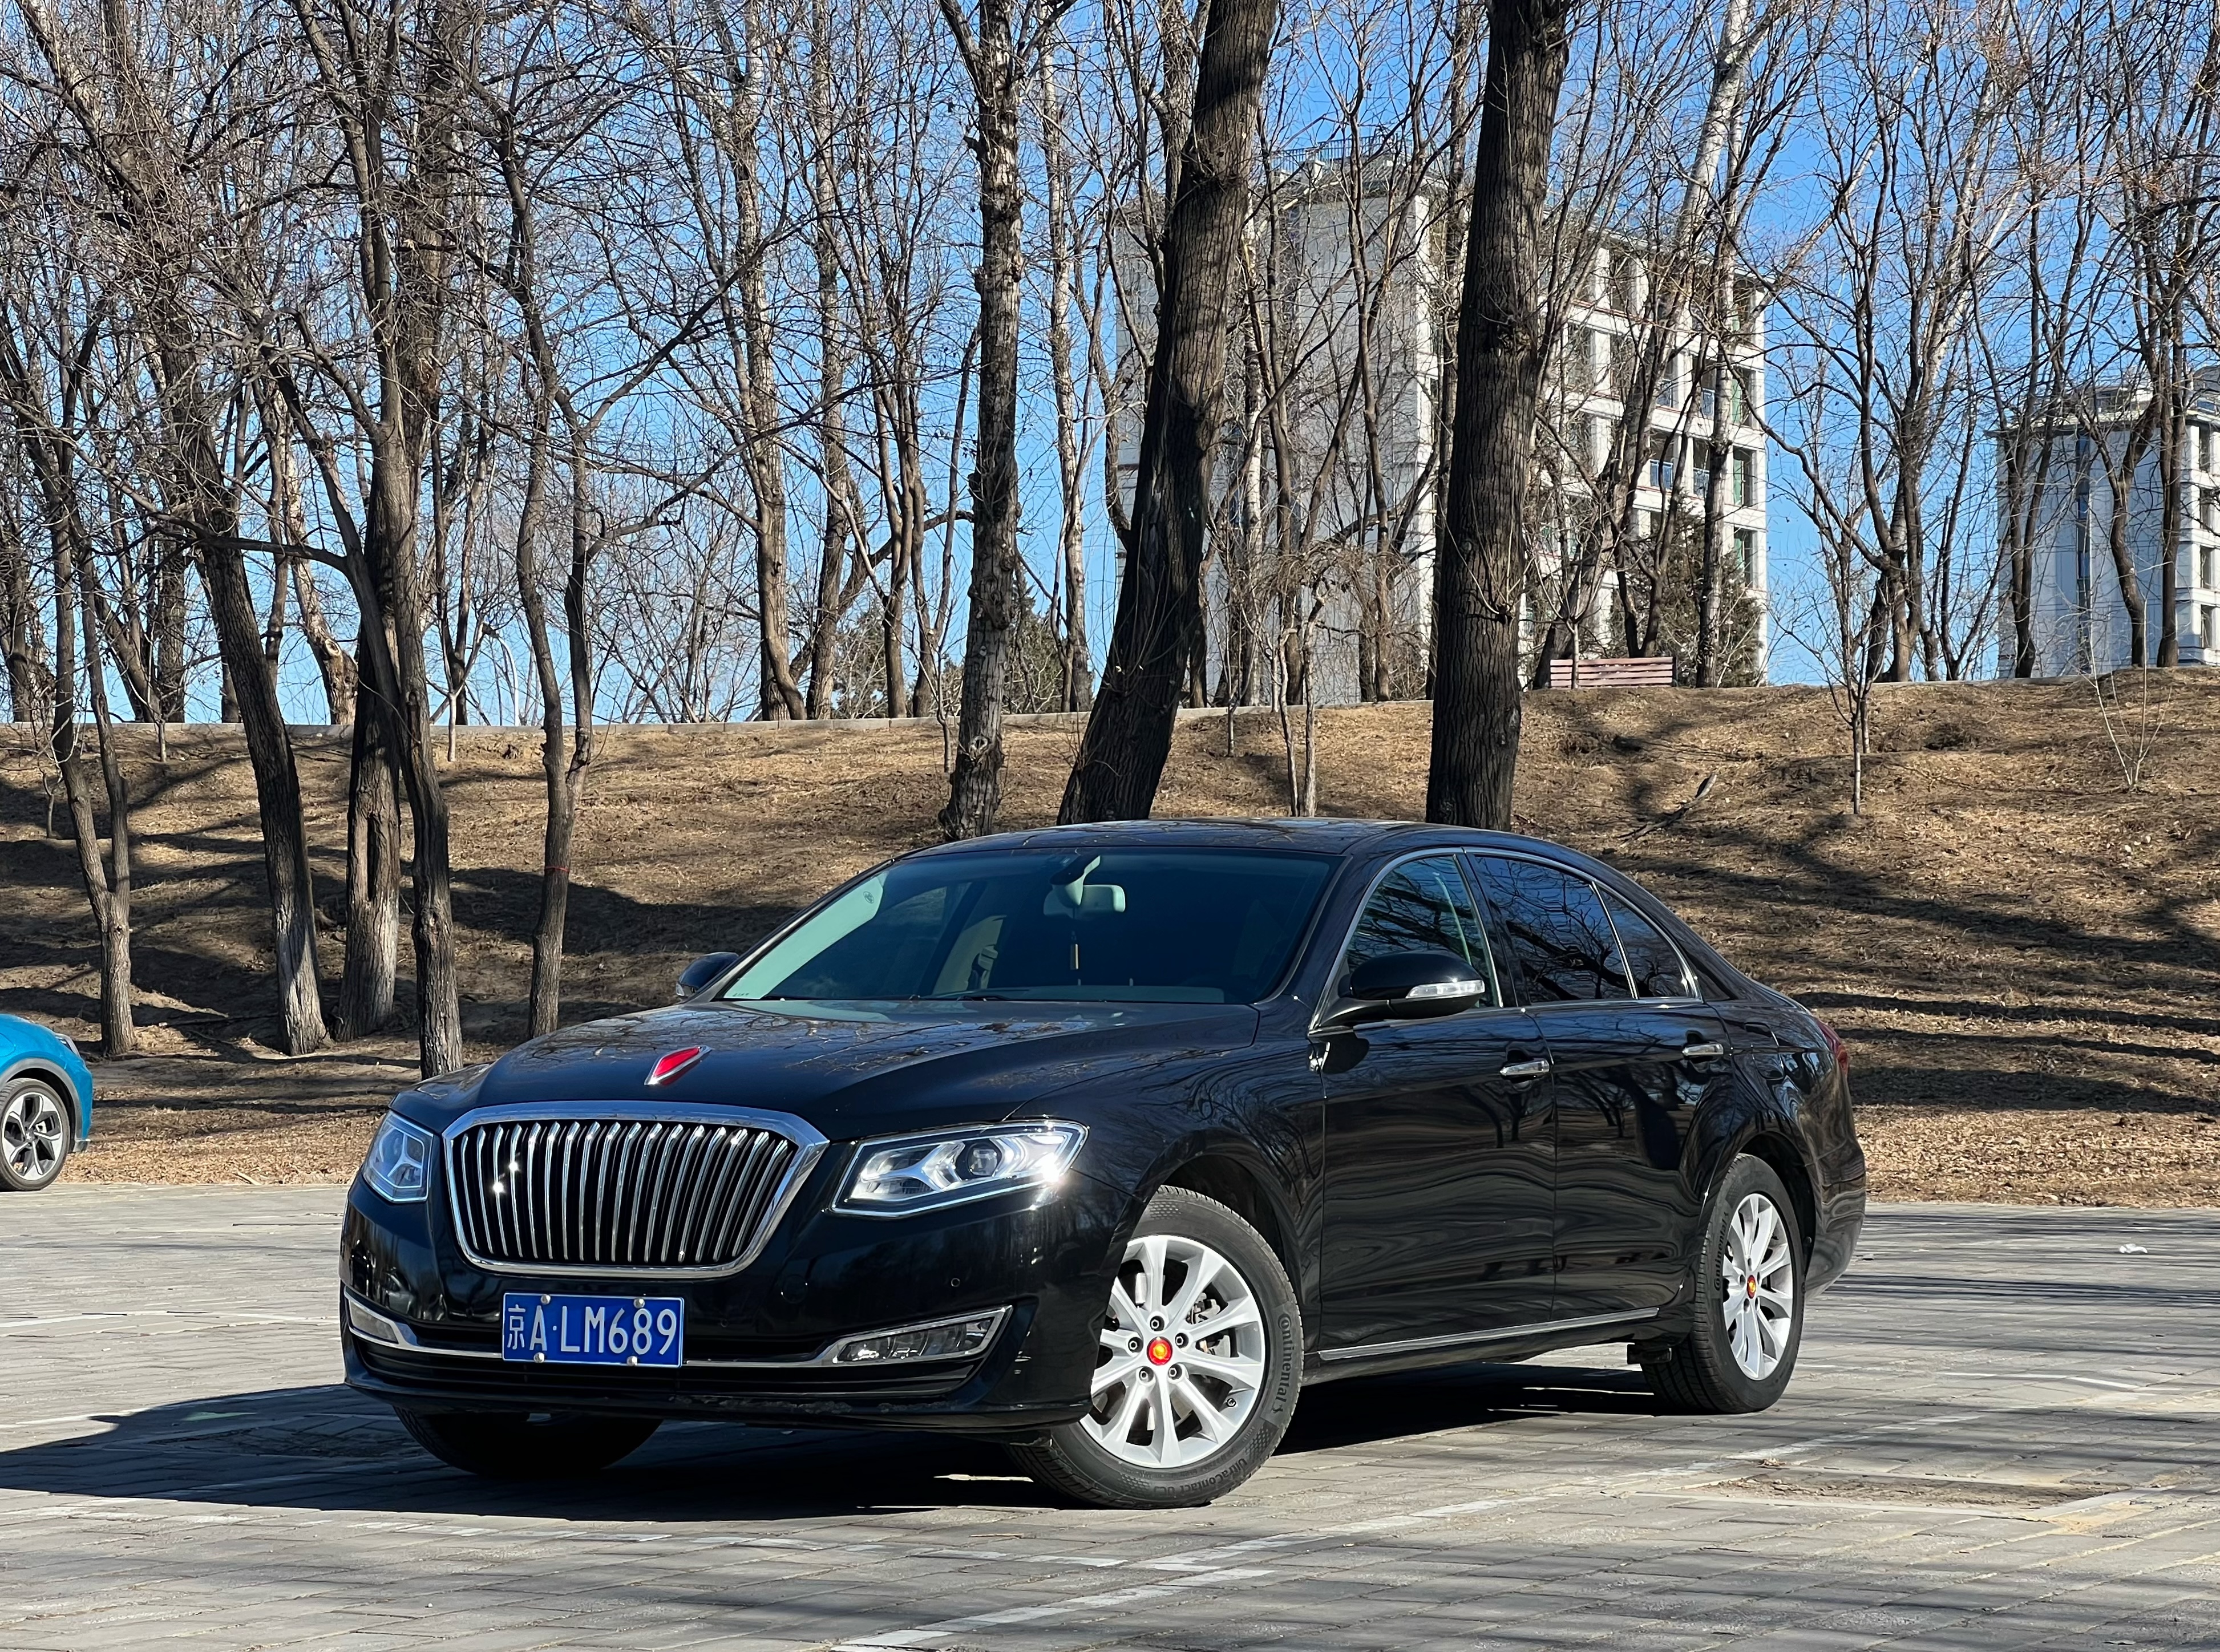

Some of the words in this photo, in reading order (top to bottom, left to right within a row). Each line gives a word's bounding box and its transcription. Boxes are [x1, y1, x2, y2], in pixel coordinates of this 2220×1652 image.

[1714, 1218, 1728, 1291] Continental
[507, 1304, 677, 1355] 京A·LM689
[1275, 1313, 1294, 1402] Continental
[1180, 1458, 1247, 1495] UltraContact
